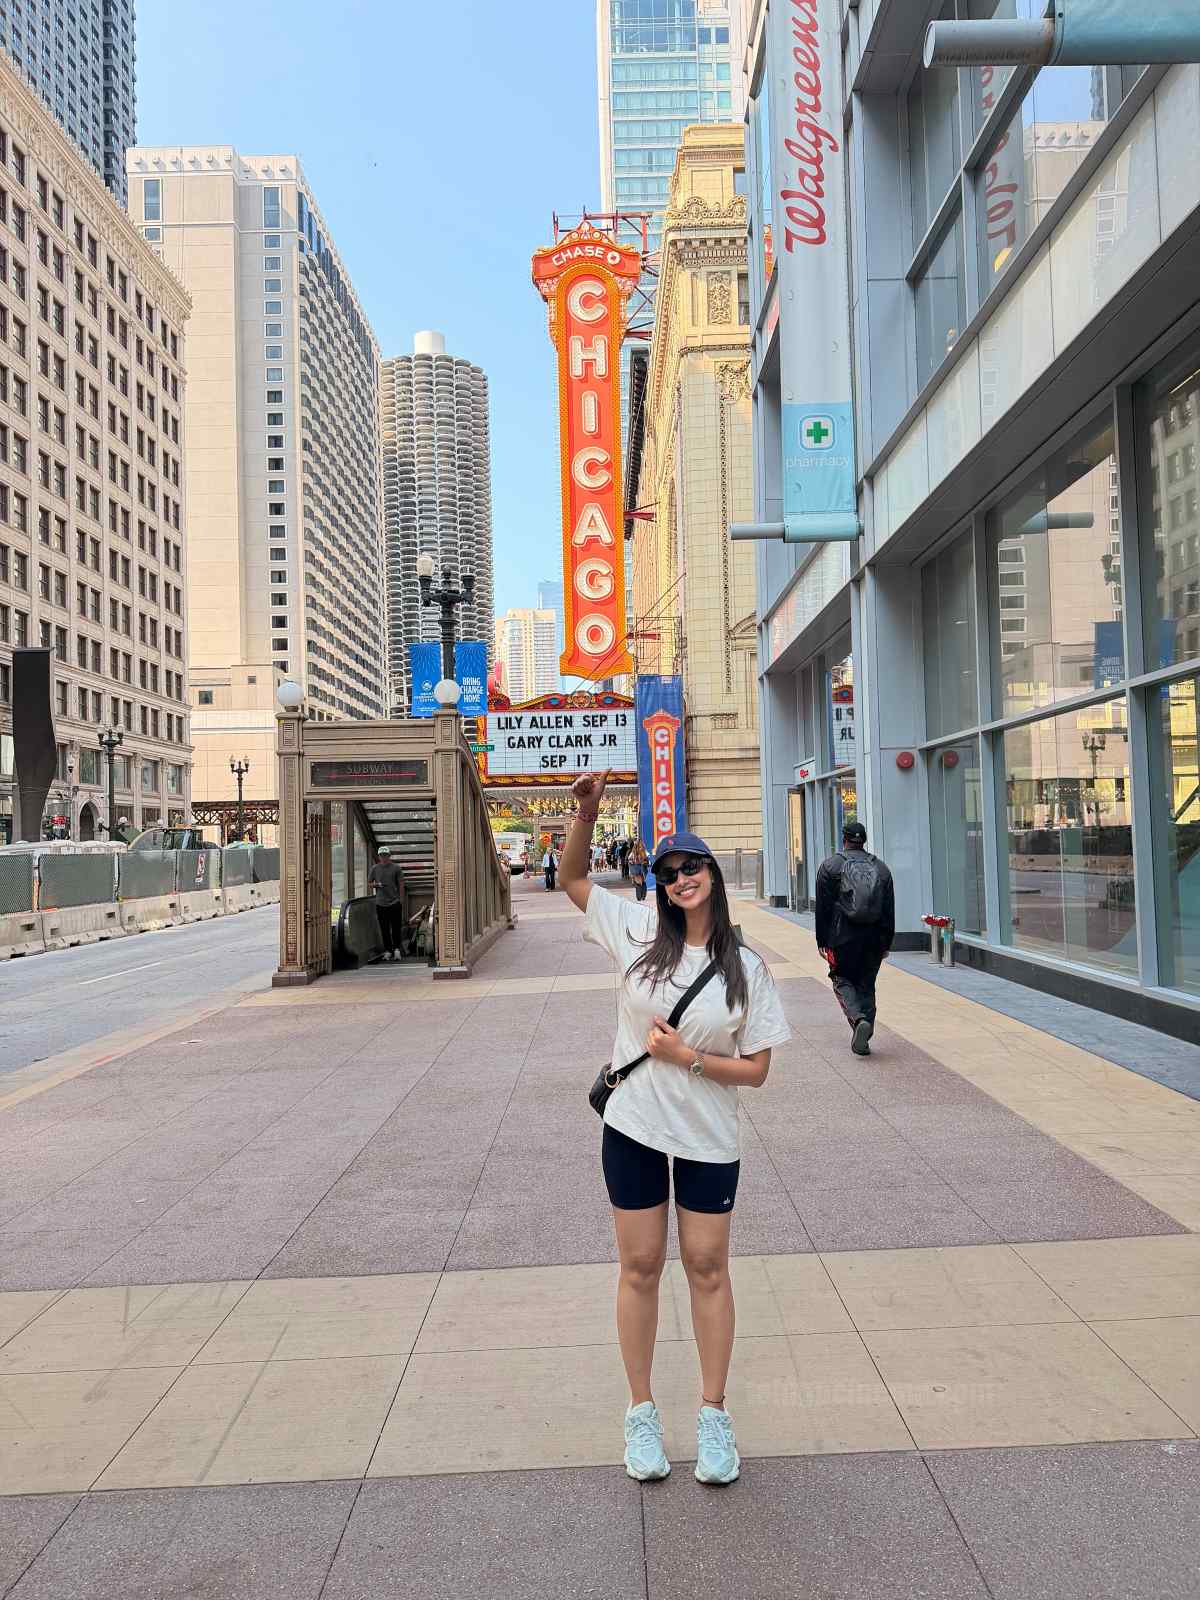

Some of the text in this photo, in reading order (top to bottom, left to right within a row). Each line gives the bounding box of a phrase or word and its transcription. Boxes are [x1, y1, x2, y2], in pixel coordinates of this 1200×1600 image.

[552, 245, 605, 266] CHASE
[567, 279, 616, 656] CHICAGO
[785, 455, 849, 473] pharmacy
[462, 677, 481, 686] BRING
[463, 694, 481, 703] HOME
[497, 714, 627, 730] LILY ALLEN SEP 13
[507, 734, 617, 749] GARY CLARK JR
[346, 762, 393, 774] SUBWAY
[541, 754, 590, 768] SEP 17
